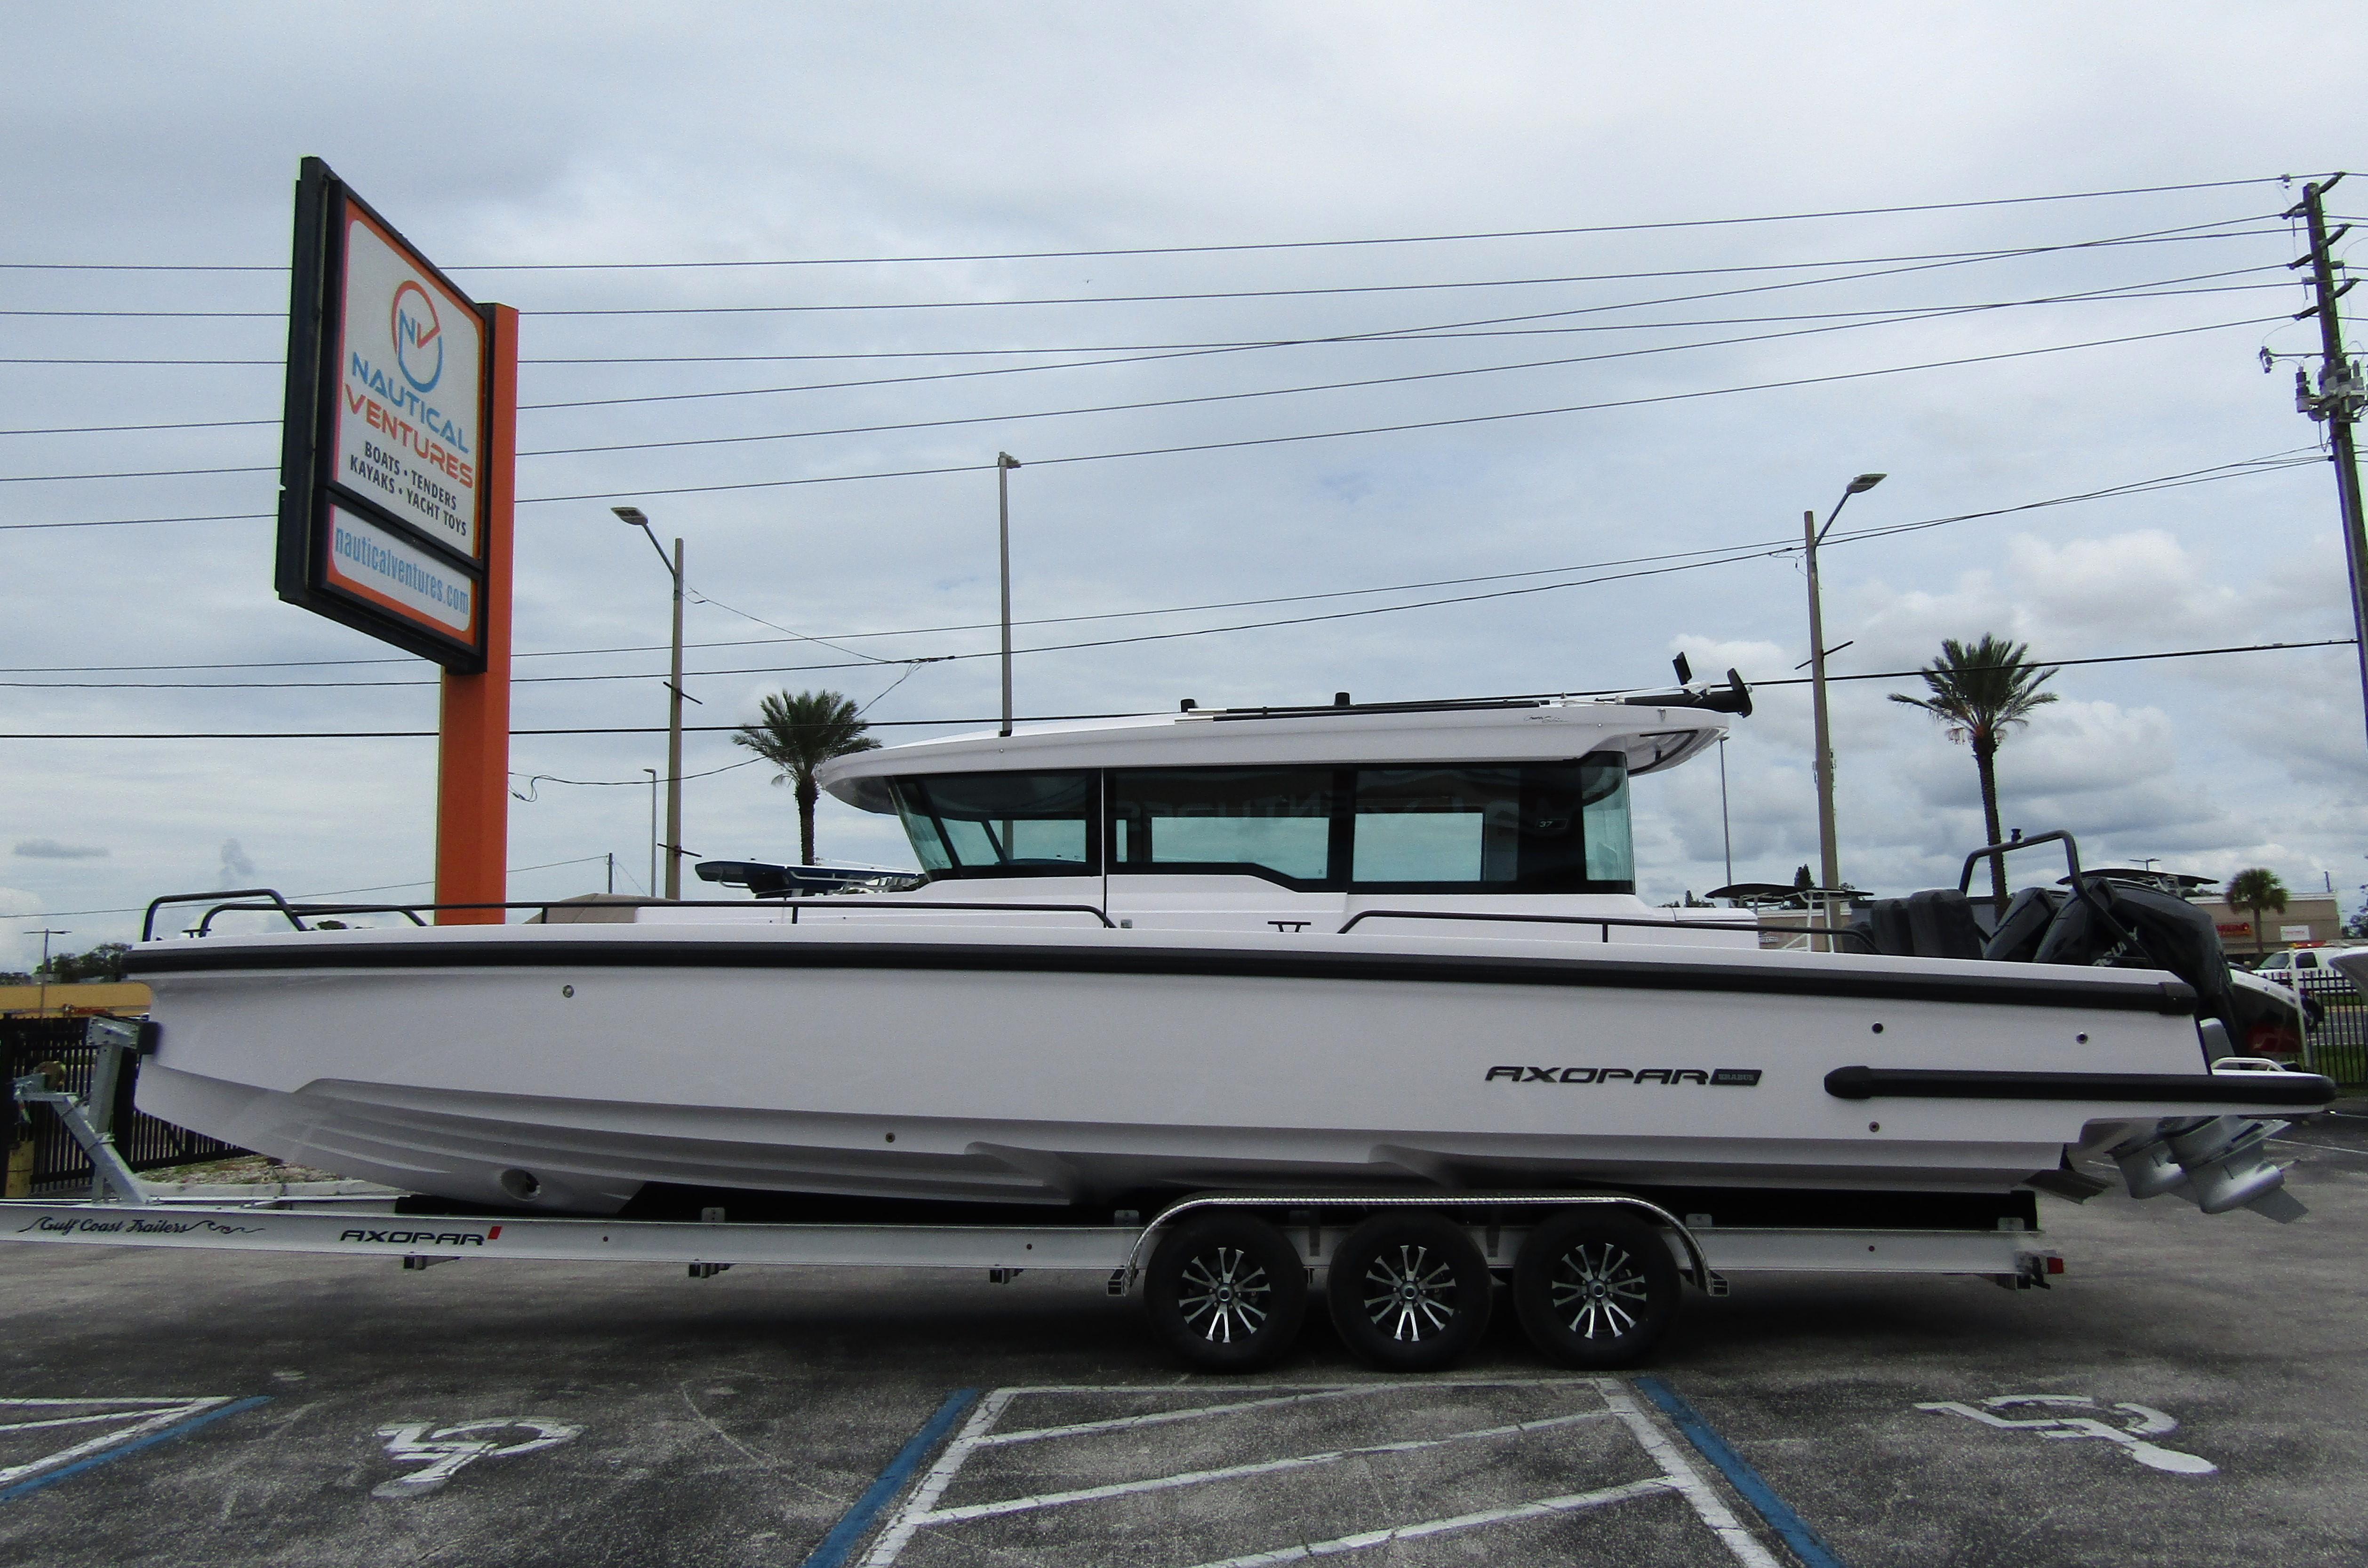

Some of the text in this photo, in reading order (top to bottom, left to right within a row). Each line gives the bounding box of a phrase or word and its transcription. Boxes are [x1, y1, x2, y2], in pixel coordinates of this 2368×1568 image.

[345, 383, 474, 488] VENTURES
[352, 351, 470, 454] NAUTICAL
[350, 454, 466, 536] KAYAKS YACHT TOYS
[365, 440, 456, 510] BOATS TENDERS
[336, 527, 469, 613] nauticalventures.com
[1485, 1066, 1709, 1084] AXOPAR
[29, 1216, 191, 1235] Gulf Coast Trailers
[340, 1229, 485, 1246] AXOPAR
